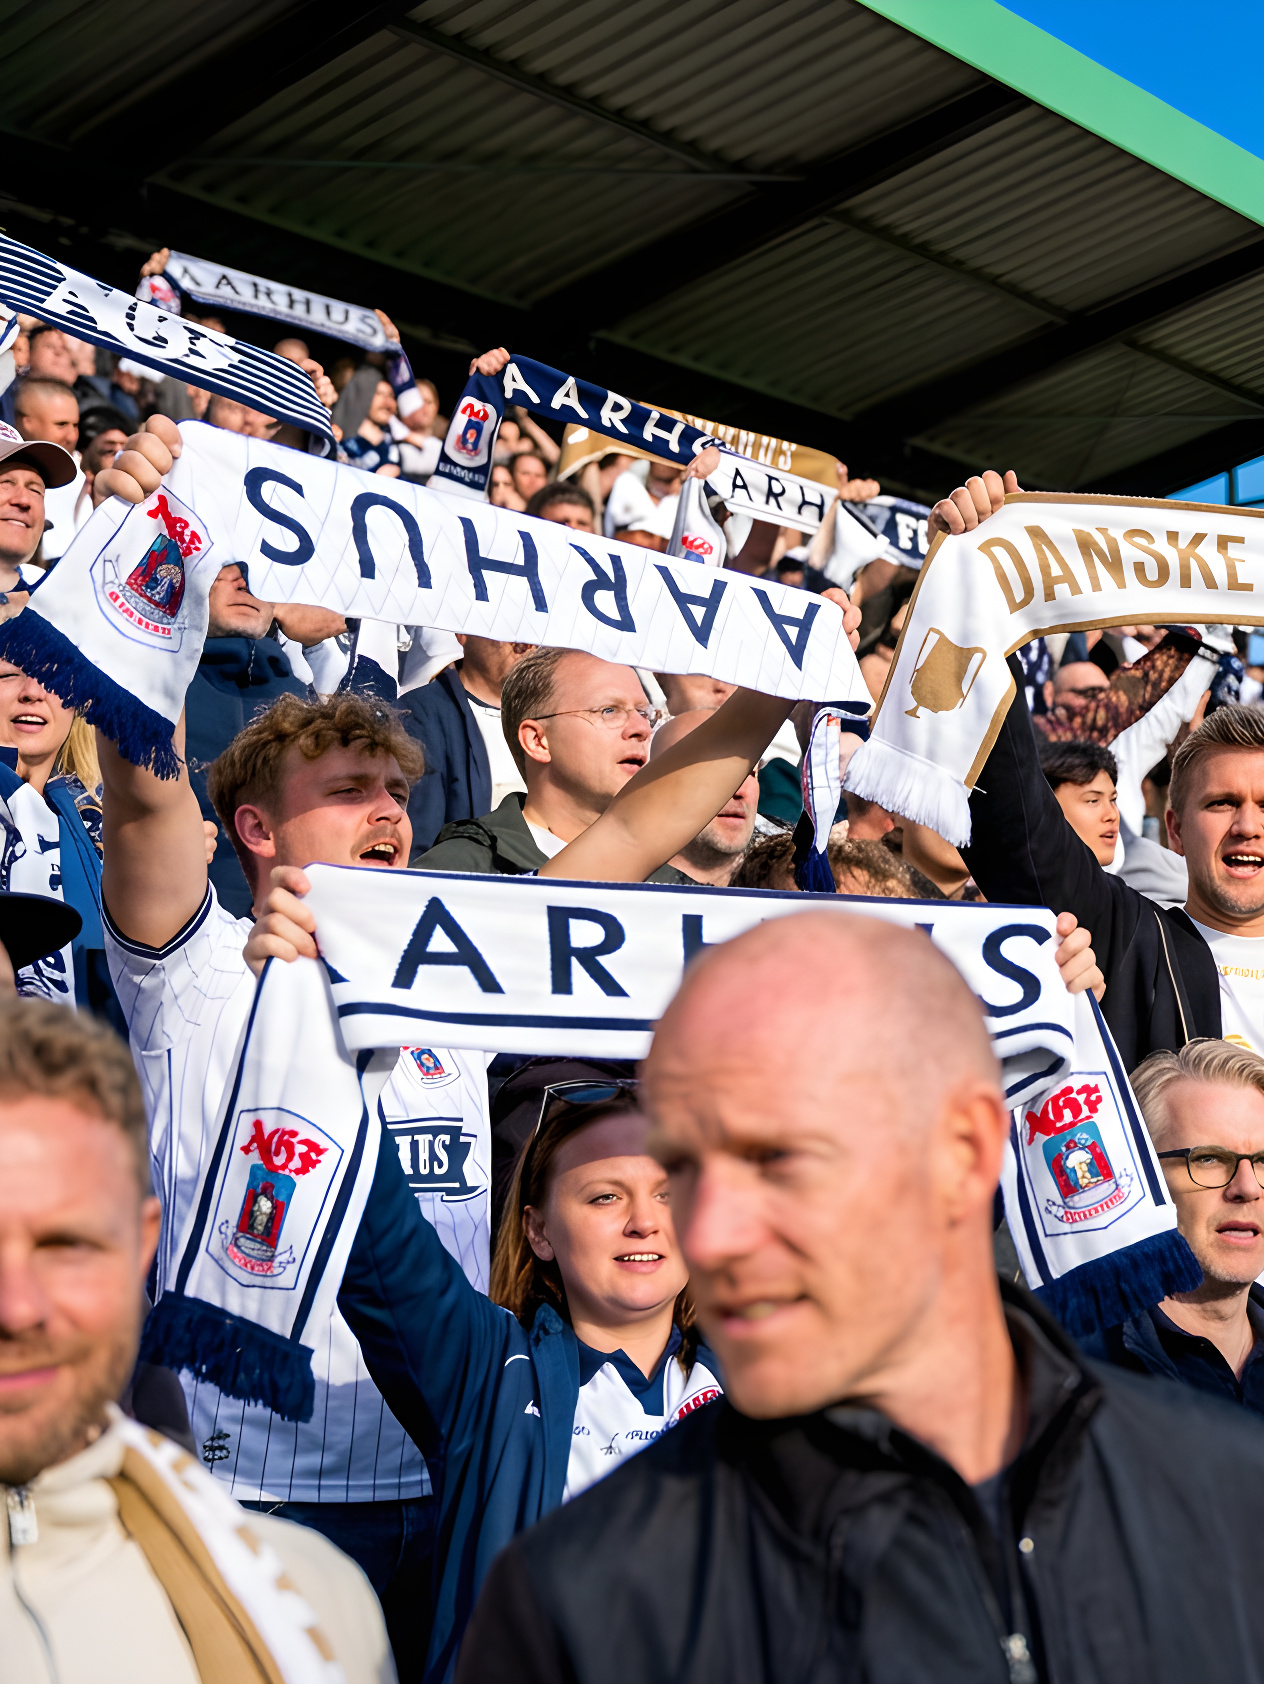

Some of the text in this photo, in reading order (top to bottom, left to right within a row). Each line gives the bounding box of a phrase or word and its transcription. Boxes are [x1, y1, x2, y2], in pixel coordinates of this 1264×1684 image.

[181, 265, 379, 338] AARHUS
[243, 466, 821, 671] AARHUS
[977, 525, 1254, 615] DANSKE
